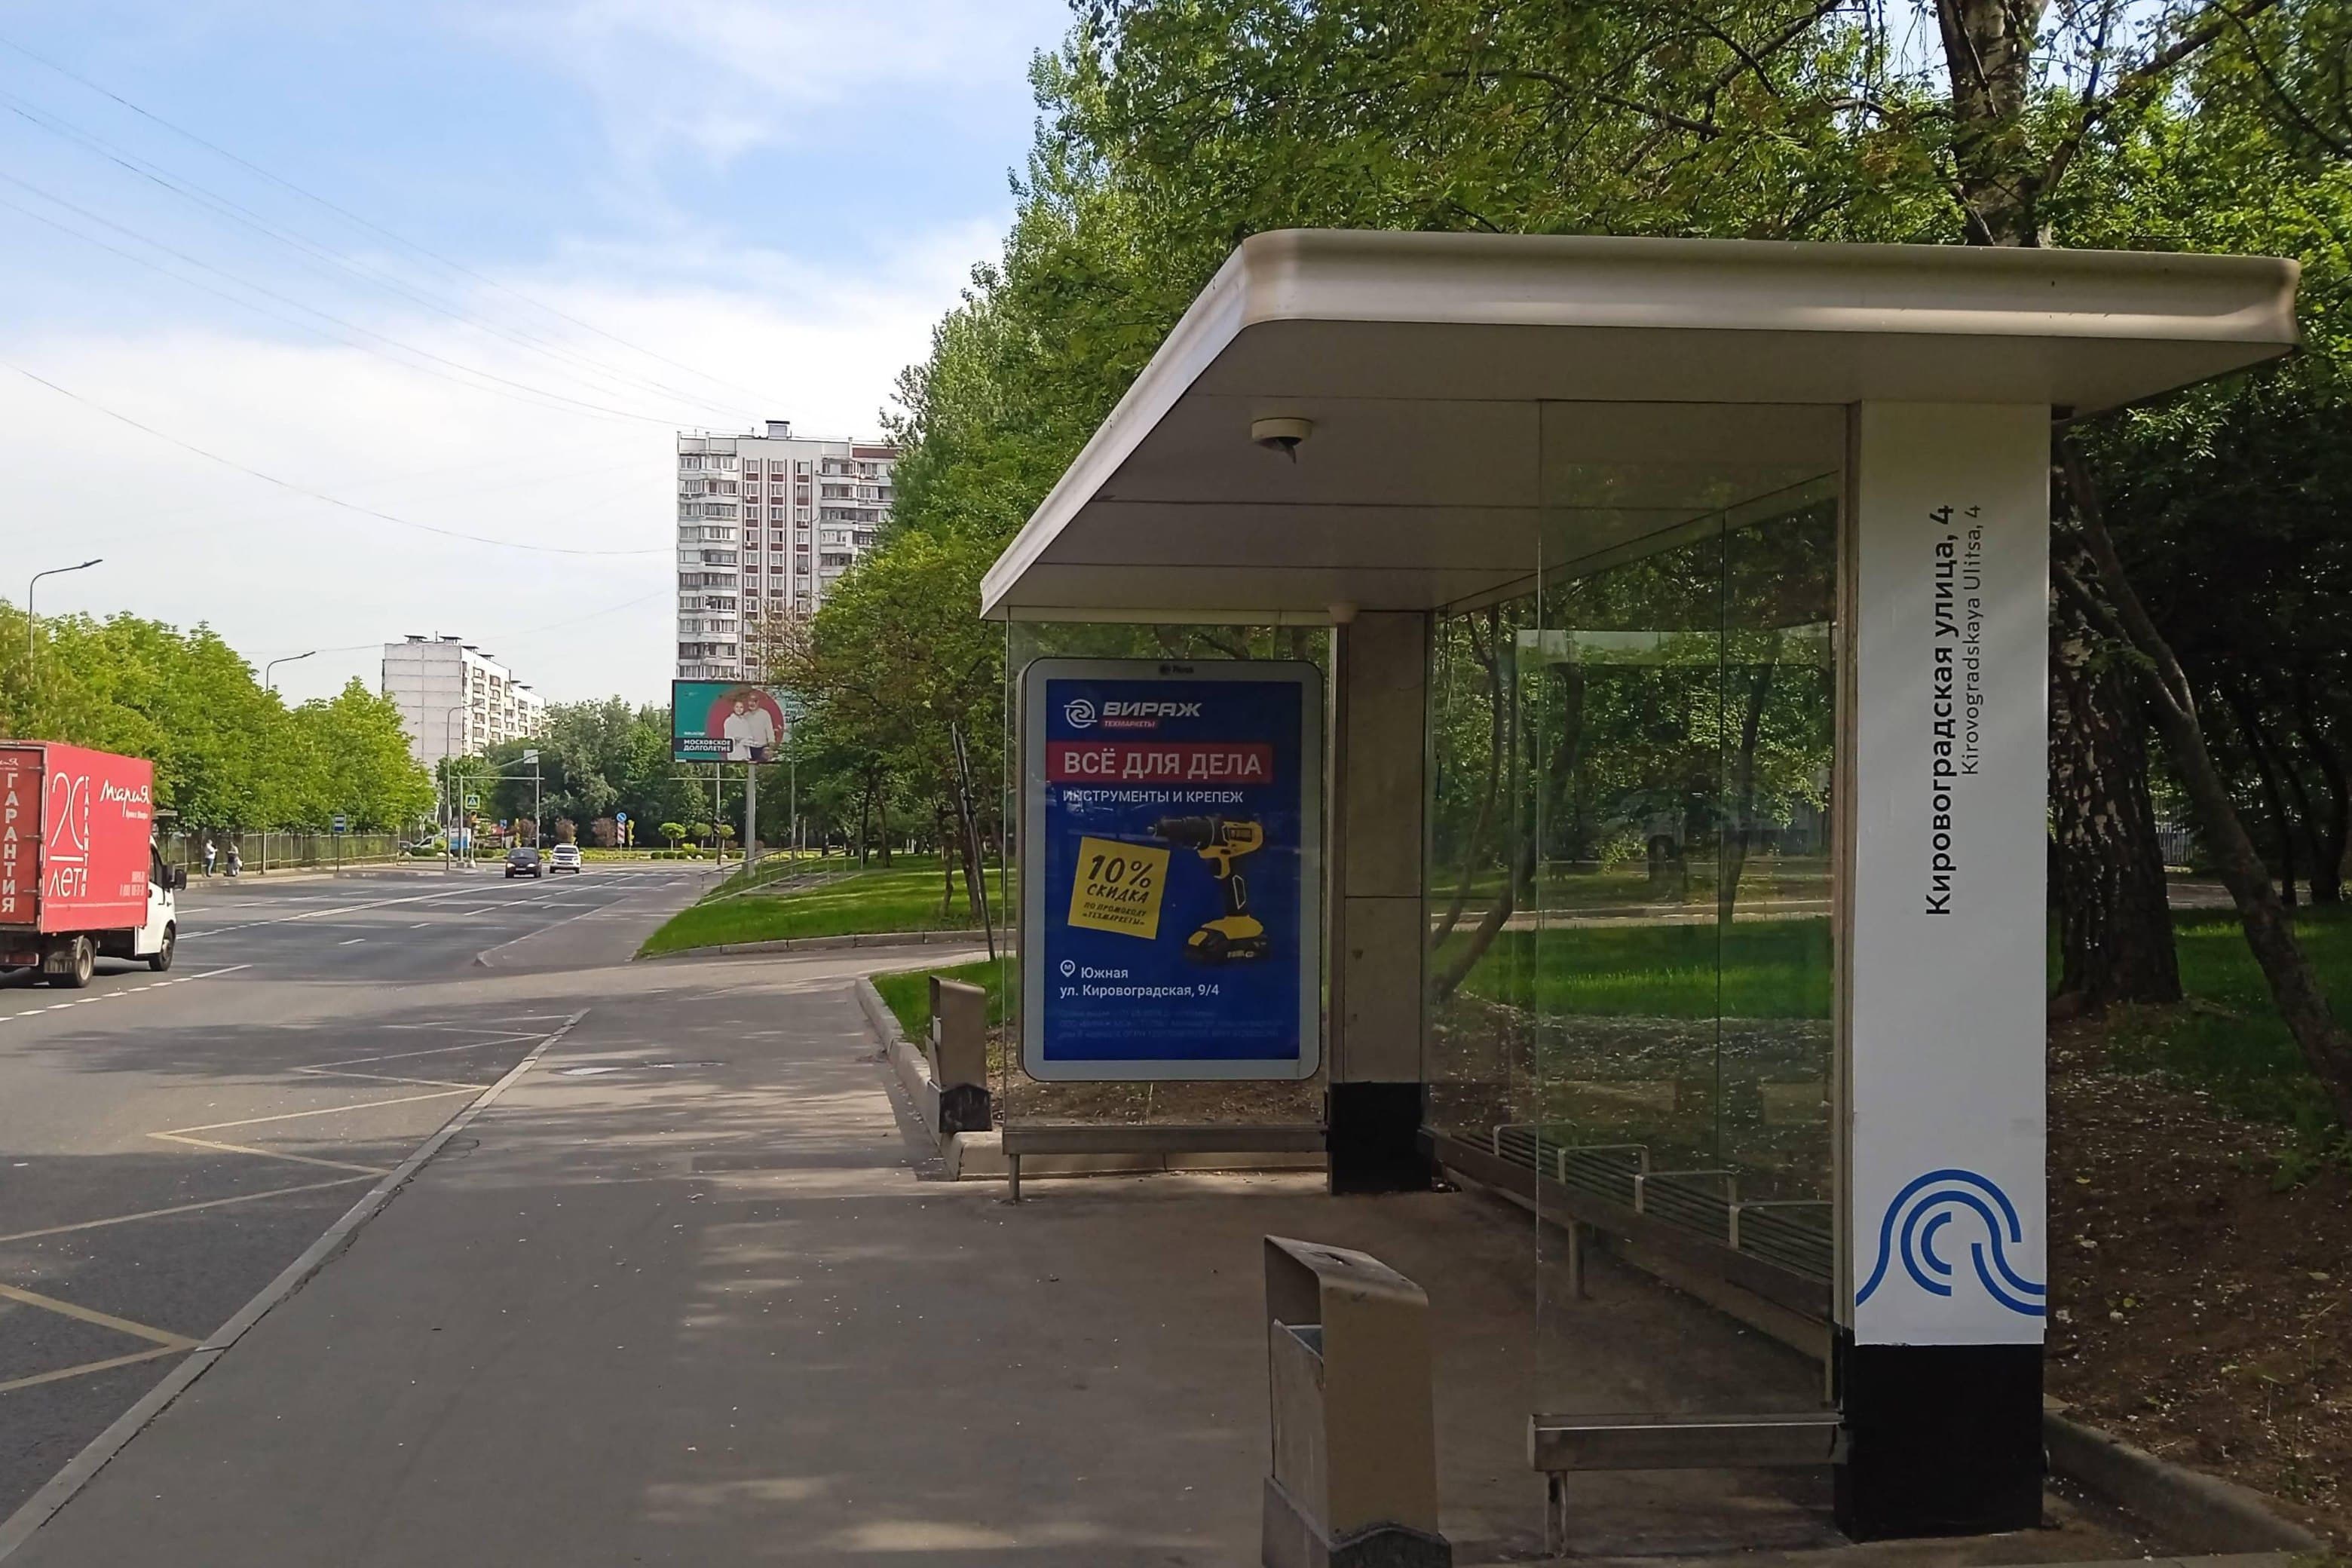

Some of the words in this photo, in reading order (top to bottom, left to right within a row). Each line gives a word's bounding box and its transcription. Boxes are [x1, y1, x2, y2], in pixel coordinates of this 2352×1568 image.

[1929, 504, 1955, 525] 4
[1964, 504, 1982, 519] 4
[1962, 525, 1984, 590] Ulitsa,
[1934, 534, 1959, 639] улица,
[1961, 597, 1984, 775] Kirovogradskaya
[1102, 701, 1202, 717] ВИРАЖ
[1104, 719, 1156, 729] ТЕХМАРКЕТЫ
[1063, 748, 1116, 774] ВСЁ
[1122, 753, 1180, 779] ДЛЯ
[1187, 753, 1263, 779] ДЕЛА
[1925, 647, 1958, 915] Кировоградская
[1062, 790, 1170, 804] ИНСТРУМЕНТЫ
[1173, 790, 1183, 804] И
[1186, 790, 1245, 804] КРЕПЕЖ
[1, 772, 19, 914] ГАРАНТИЯ
[81, 775, 90, 898] ГАРАНТИЯ
[1088, 854, 1154, 888] 10%
[1086, 883, 1150, 904] СКИДКА
[1080, 966, 1129, 979] Южная
[1059, 986, 1079, 999] ул.
[1082, 985, 1196, 999] Кировоградская,
[1197, 984, 1220, 997] 9/4
